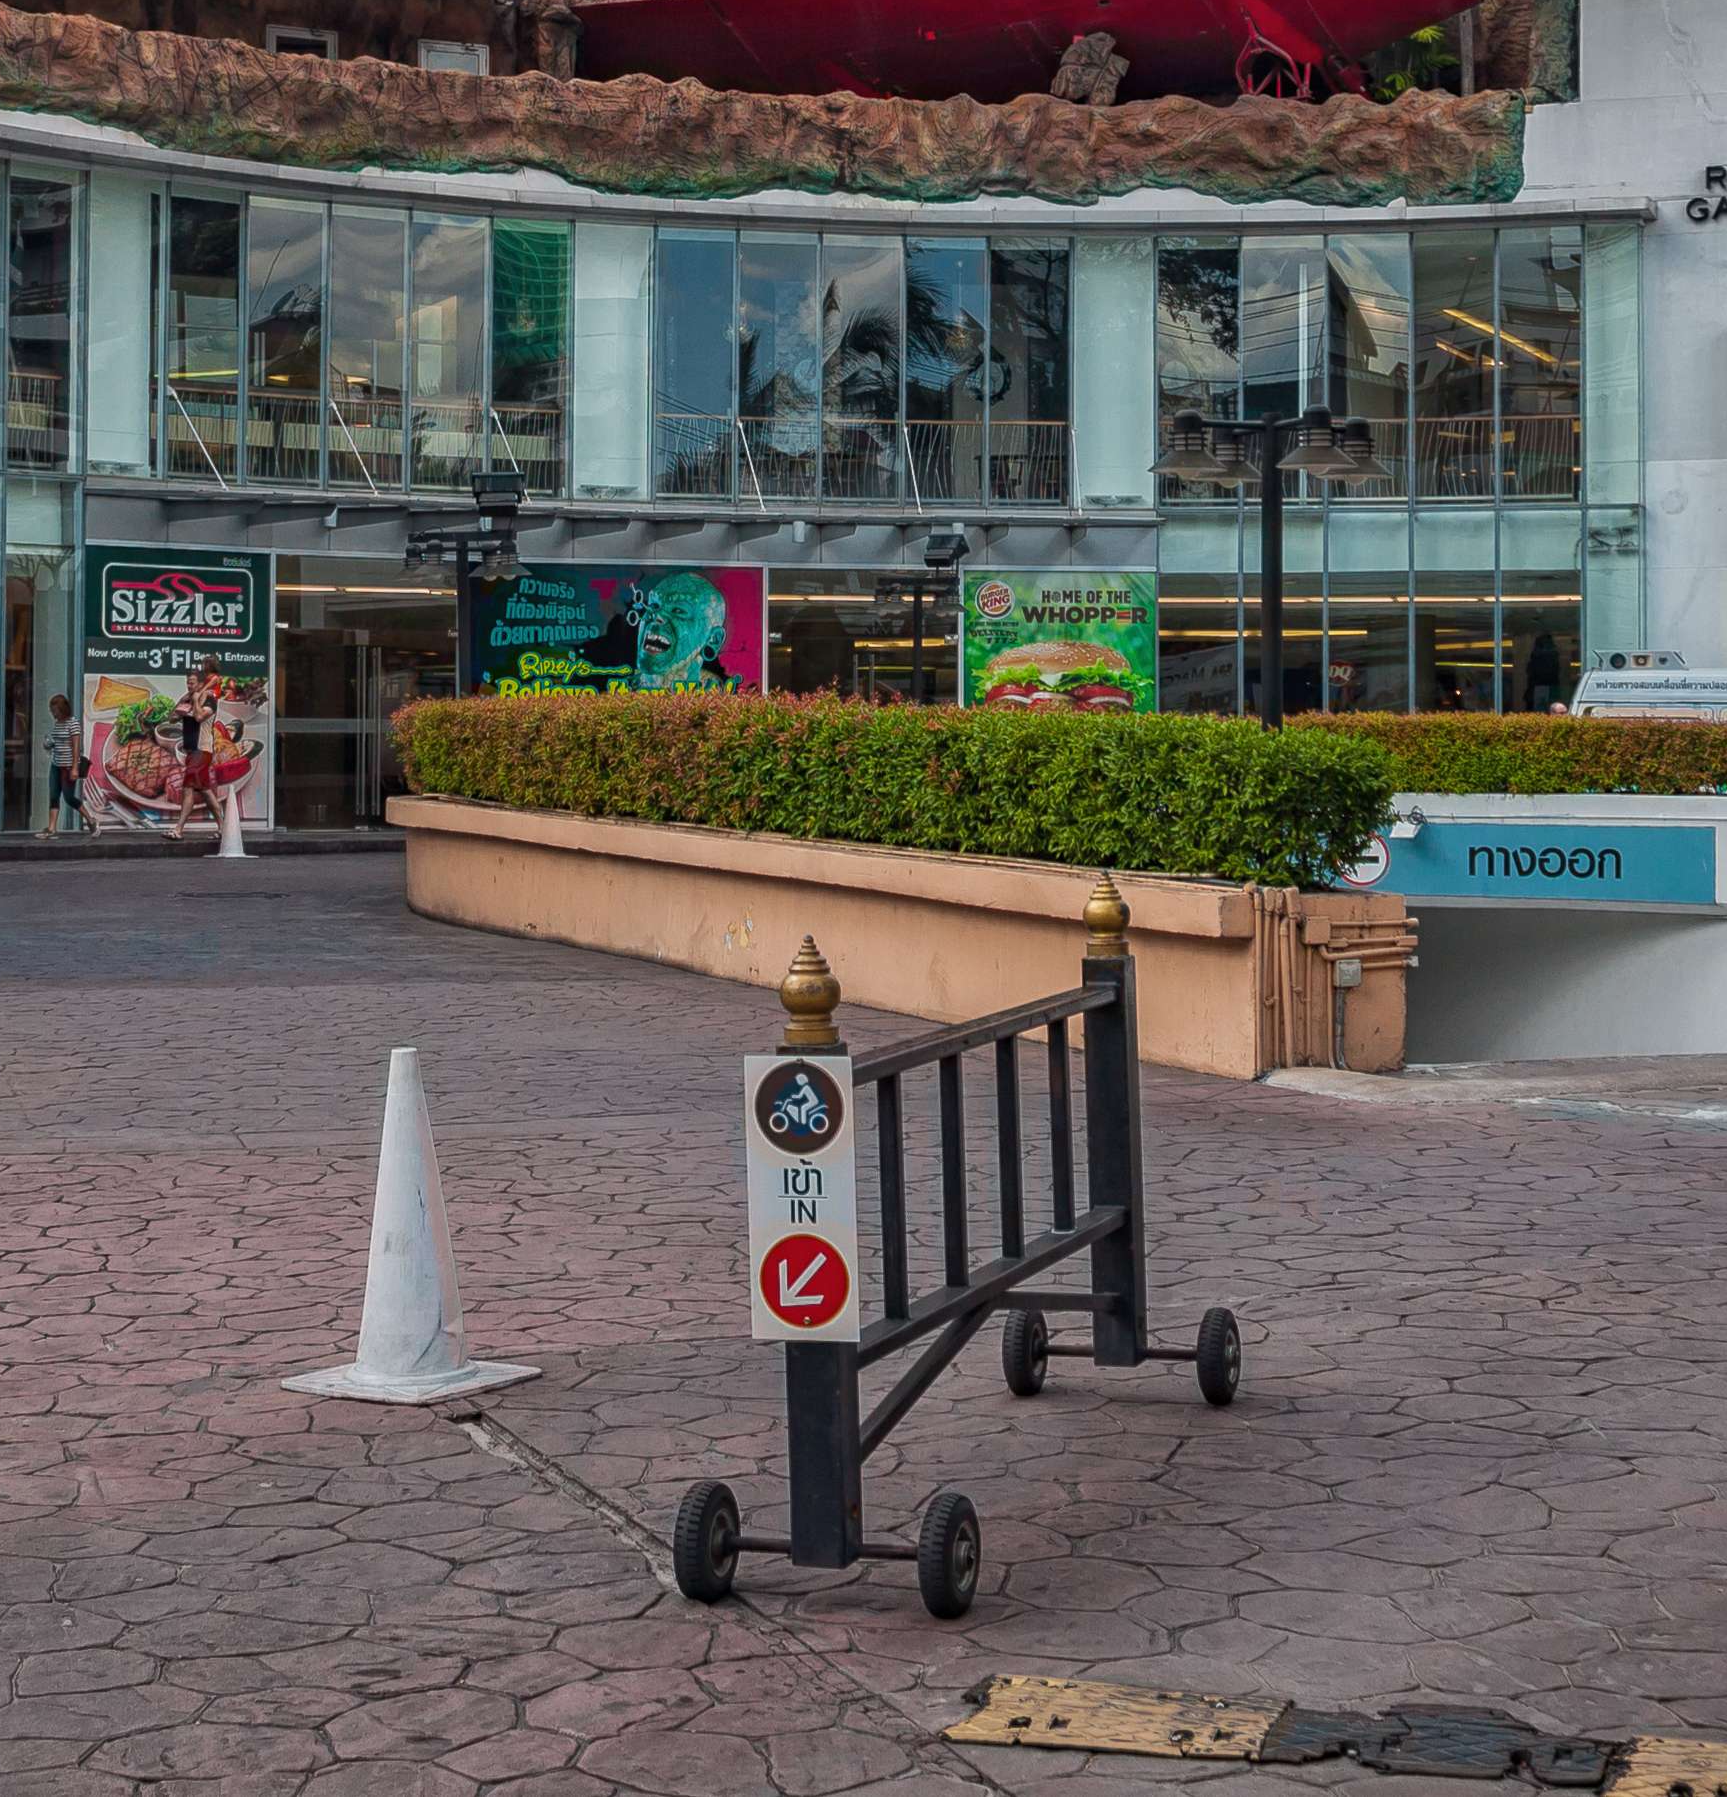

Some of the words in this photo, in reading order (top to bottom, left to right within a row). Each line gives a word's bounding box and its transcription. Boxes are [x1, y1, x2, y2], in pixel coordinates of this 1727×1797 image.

[982, 594, 1010, 609] KING
[1041, 590, 1082, 603] HOME
[1086, 590, 1103, 603] OF
[1107, 590, 1131, 603] THE
[111, 589, 244, 627] Sizzler
[1022, 606, 1149, 624] WHOPPER
[116, 625, 146, 633] STEAK
[155, 625, 198, 634] SEAFOOD
[206, 627, 237, 635] SALAD
[88, 647, 108, 658] Now
[111, 648, 136, 661] Open
[138, 650, 148, 659] at
[193, 651, 222, 662] Beh
[224, 652, 265, 663] Entrance
[1468, 846, 1622, 880] ทางออก
[783, 1158, 823, 1196] เข้า
[790, 1199, 817, 1224] IN
